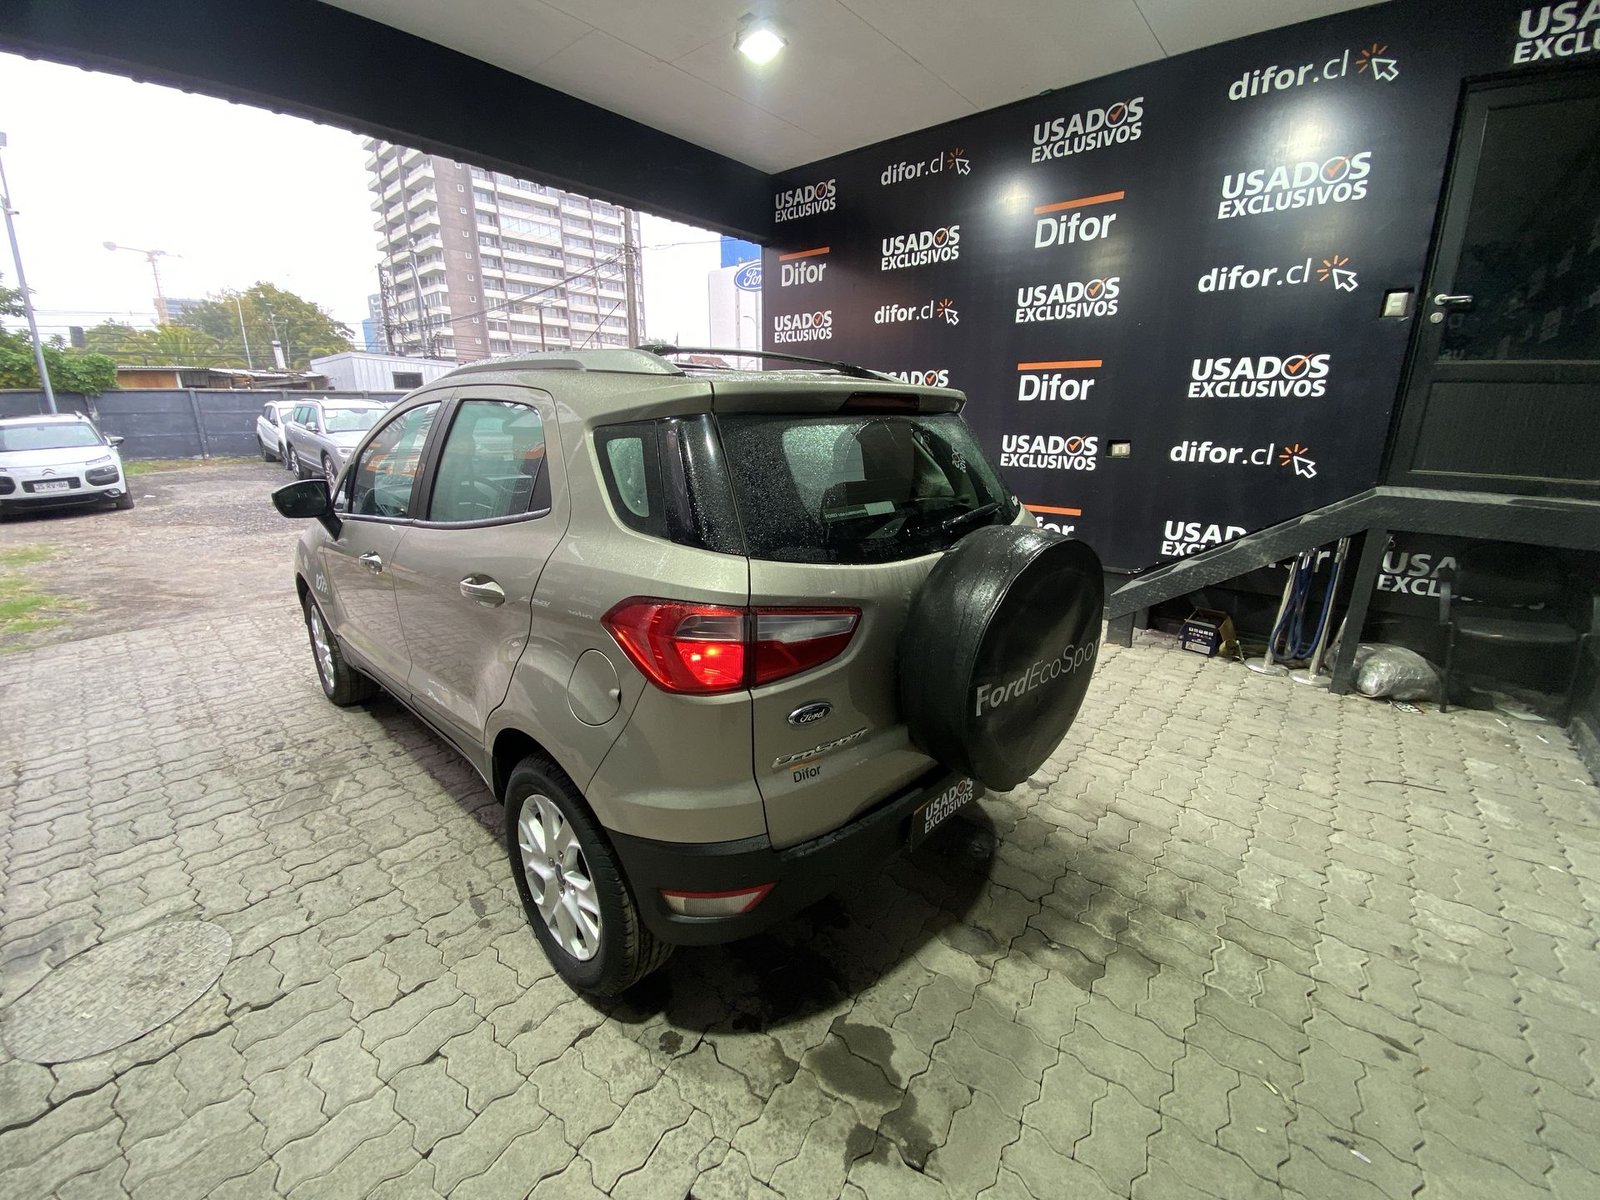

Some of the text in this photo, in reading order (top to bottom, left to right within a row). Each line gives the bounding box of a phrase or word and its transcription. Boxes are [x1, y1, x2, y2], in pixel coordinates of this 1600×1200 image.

[1518, 0, 1600, 39] USA
[1228, 49, 1350, 101] difor.cl
[1033, 96, 1144, 145] USADOS
[1031, 122, 1142, 163] EXCLUSIVOS
[880, 151, 944, 186] difor.cl
[1221, 151, 1372, 199] USADOS
[775, 178, 836, 210] USADOS
[1217, 179, 1368, 220] EXCLUSIVOS
[775, 198, 836, 223] EXCLUSIVOS
[882, 224, 960, 256] USADOS
[1034, 211, 1117, 248] Difor
[881, 244, 959, 271] EXCLUSIVOS
[781, 262, 827, 287] Difor
[1198, 257, 1312, 293] difor.cl
[1017, 276, 1121, 307] USADOS
[774, 310, 833, 331] USADOS
[874, 300, 934, 325] difor.cl
[1015, 298, 1119, 323] EXCLUSIVOS
[774, 326, 833, 344] EXCLUSIVOS
[884, 369, 949, 388] ADOS
[1191, 353, 1331, 380] USADOS
[1018, 373, 1095, 401] Difor
[1188, 379, 1327, 398] EXCLUSIVOS
[1001, 434, 1099, 457] USADOS
[1170, 440, 1274, 466] difor.cl
[1000, 452, 1097, 472] EXCLUSIVOS
[1036, 516, 1075, 536] for
[1164, 520, 1248, 544] USAD
[1382, 551, 1457, 578] USA
[976, 637, 1100, 717] FordEcoSpor
[793, 766, 821, 783] Difor
[925, 777, 973, 821] USADOS
[925, 789, 973, 834] EXCLUSIVOS
